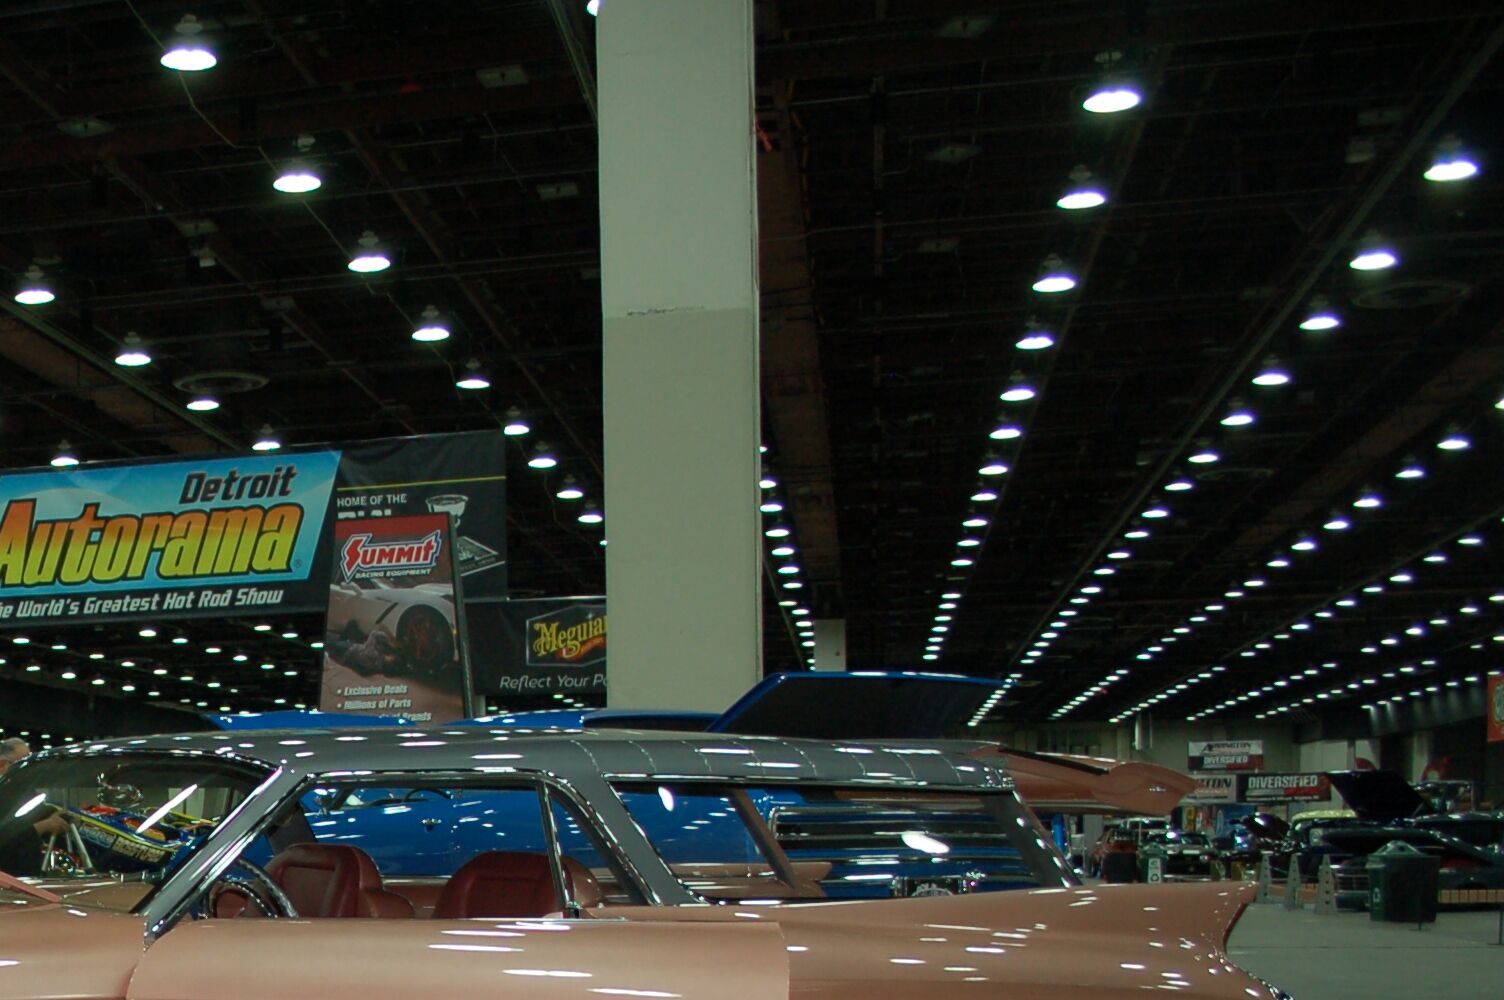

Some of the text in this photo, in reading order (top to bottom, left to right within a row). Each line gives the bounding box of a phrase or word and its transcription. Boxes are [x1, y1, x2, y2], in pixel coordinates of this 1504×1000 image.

[179, 465, 297, 503] Detroit
[337, 493, 407, 507] HOME OF THE
[16, 599, 80, 618] World's
[83, 595, 158, 614] Greatest
[163, 591, 196, 610] Hot
[198, 589, 231, 608] Rod
[234, 588, 284, 606] Show
[499, 675, 551, 691] Reflect
[557, 675, 589, 688] Your
[389, 699, 412, 708] Parts
[1248, 775, 1318, 788] DIVERSIFIED
